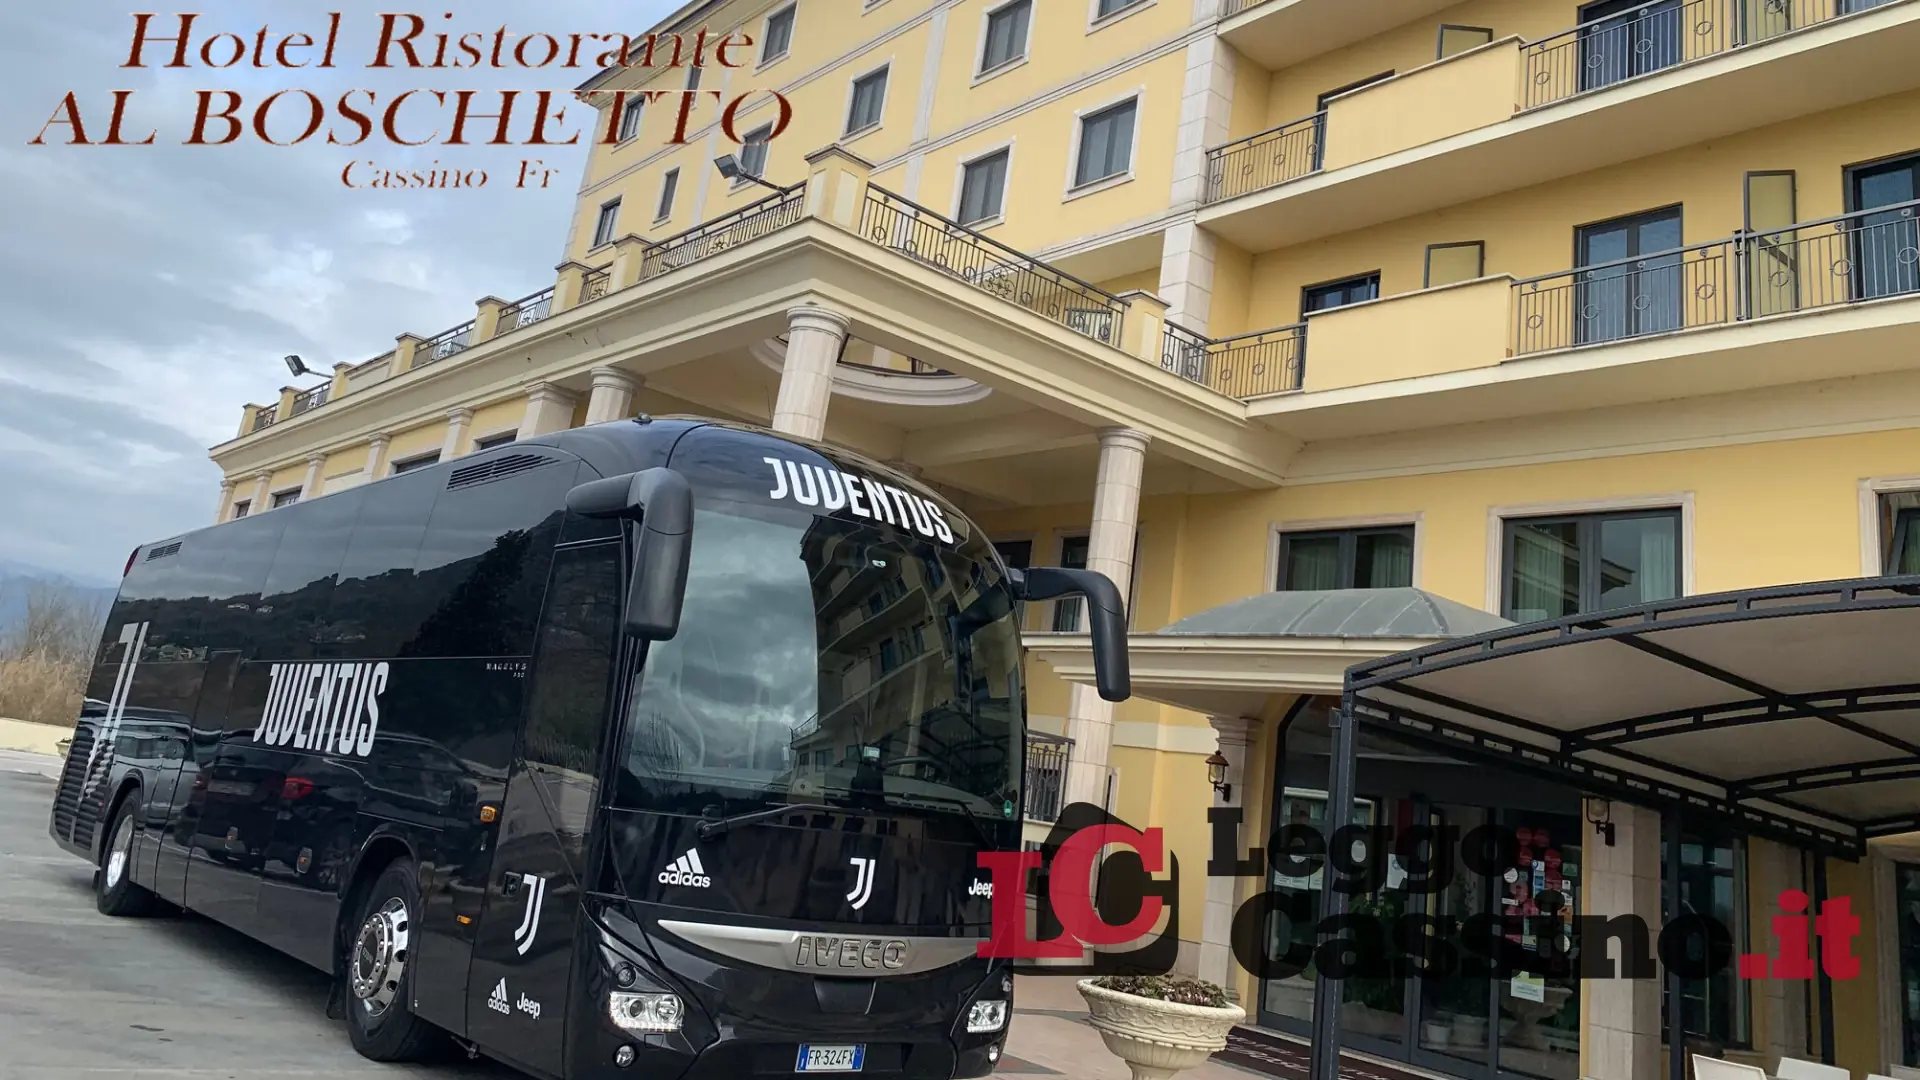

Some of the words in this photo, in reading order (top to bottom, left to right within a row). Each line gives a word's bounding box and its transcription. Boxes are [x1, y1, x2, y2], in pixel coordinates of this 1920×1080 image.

[763, 456, 954, 544] JUVENTUS
[252, 661, 390, 757] JUVENTUS
[658, 870, 711, 888] adidas
[796, 935, 907, 969] IVECO
[487, 997, 511, 1015] adidas
[516, 991, 541, 1020] Jeep
